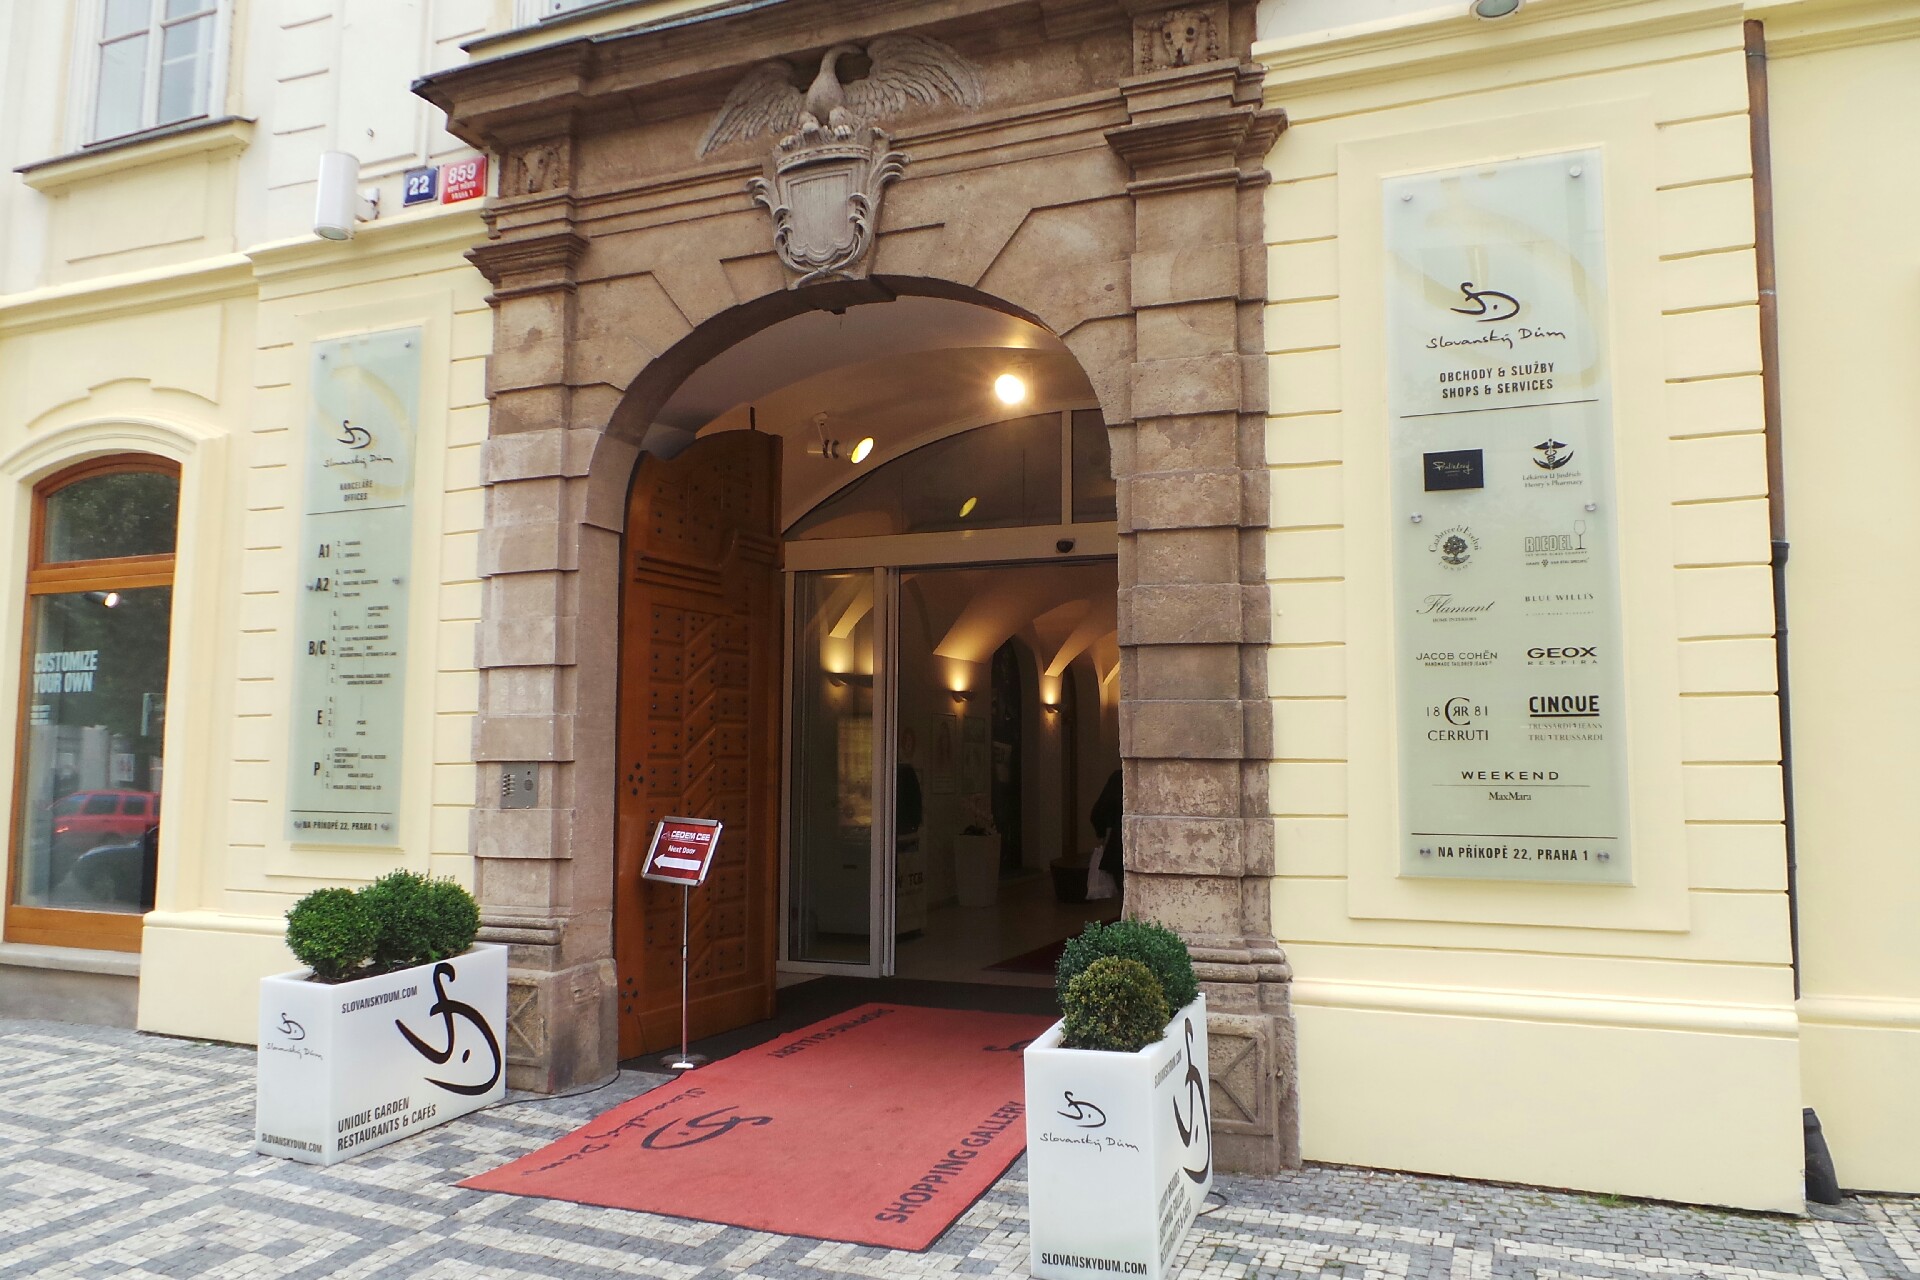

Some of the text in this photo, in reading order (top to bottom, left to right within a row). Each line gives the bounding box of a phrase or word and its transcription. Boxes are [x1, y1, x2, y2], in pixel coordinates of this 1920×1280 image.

[448, 163, 477, 184] 859
[409, 175, 429, 196] 22
[1426, 327, 1566, 350] Slovanský Dům
[1440, 361, 1554, 382] OBCHODY & SLUŽBY
[1442, 379, 1554, 398] SHOPS & SERVICES
[344, 492, 368, 502] OFFICES
[318, 544, 330, 558] A1
[1524, 535, 1572, 552] RIEDEL
[314, 577, 330, 592] A2
[1416, 594, 1495, 614] Flamant
[1525, 594, 1550, 602] BLUE
[308, 640, 326, 656] B/C
[1416, 652, 1454, 660] JACOB
[1527, 647, 1597, 658] GEOX
[34, 650, 98, 672] CUSTOMIZE
[32, 672, 94, 693] YOUR OWN
[1529, 696, 1600, 712] CINQUE
[317, 710, 323, 724] E
[1528, 722, 1572, 730] TRUSSARDI
[1428, 730, 1488, 741] CERRUTI
[314, 762, 320, 776] P
[1462, 771, 1560, 780] WEEKEND
[1488, 792, 1532, 800] MaxMara
[340, 822, 349, 831] 22,
[351, 822, 372, 831] PRAHA
[668, 844, 696, 854] Next Door
[1438, 846, 1453, 858] NA
[1513, 848, 1532, 860] 22,
[1538, 849, 1578, 860] PRAHA
[1583, 850, 1588, 861] 1
[342, 986, 418, 1014] SLOVANSKYDUM.COM
[338, 1096, 410, 1134] UNIQUE GARDEN
[338, 1102, 436, 1151] RESTAURANTS & CAFÉS
[262, 1133, 322, 1154] SLOVANSKYDUM.COM
[875, 1100, 1026, 1224] SHOPPING GALLERY
[1042, 1252, 1147, 1275] SLOVANSKYDUM.COM
